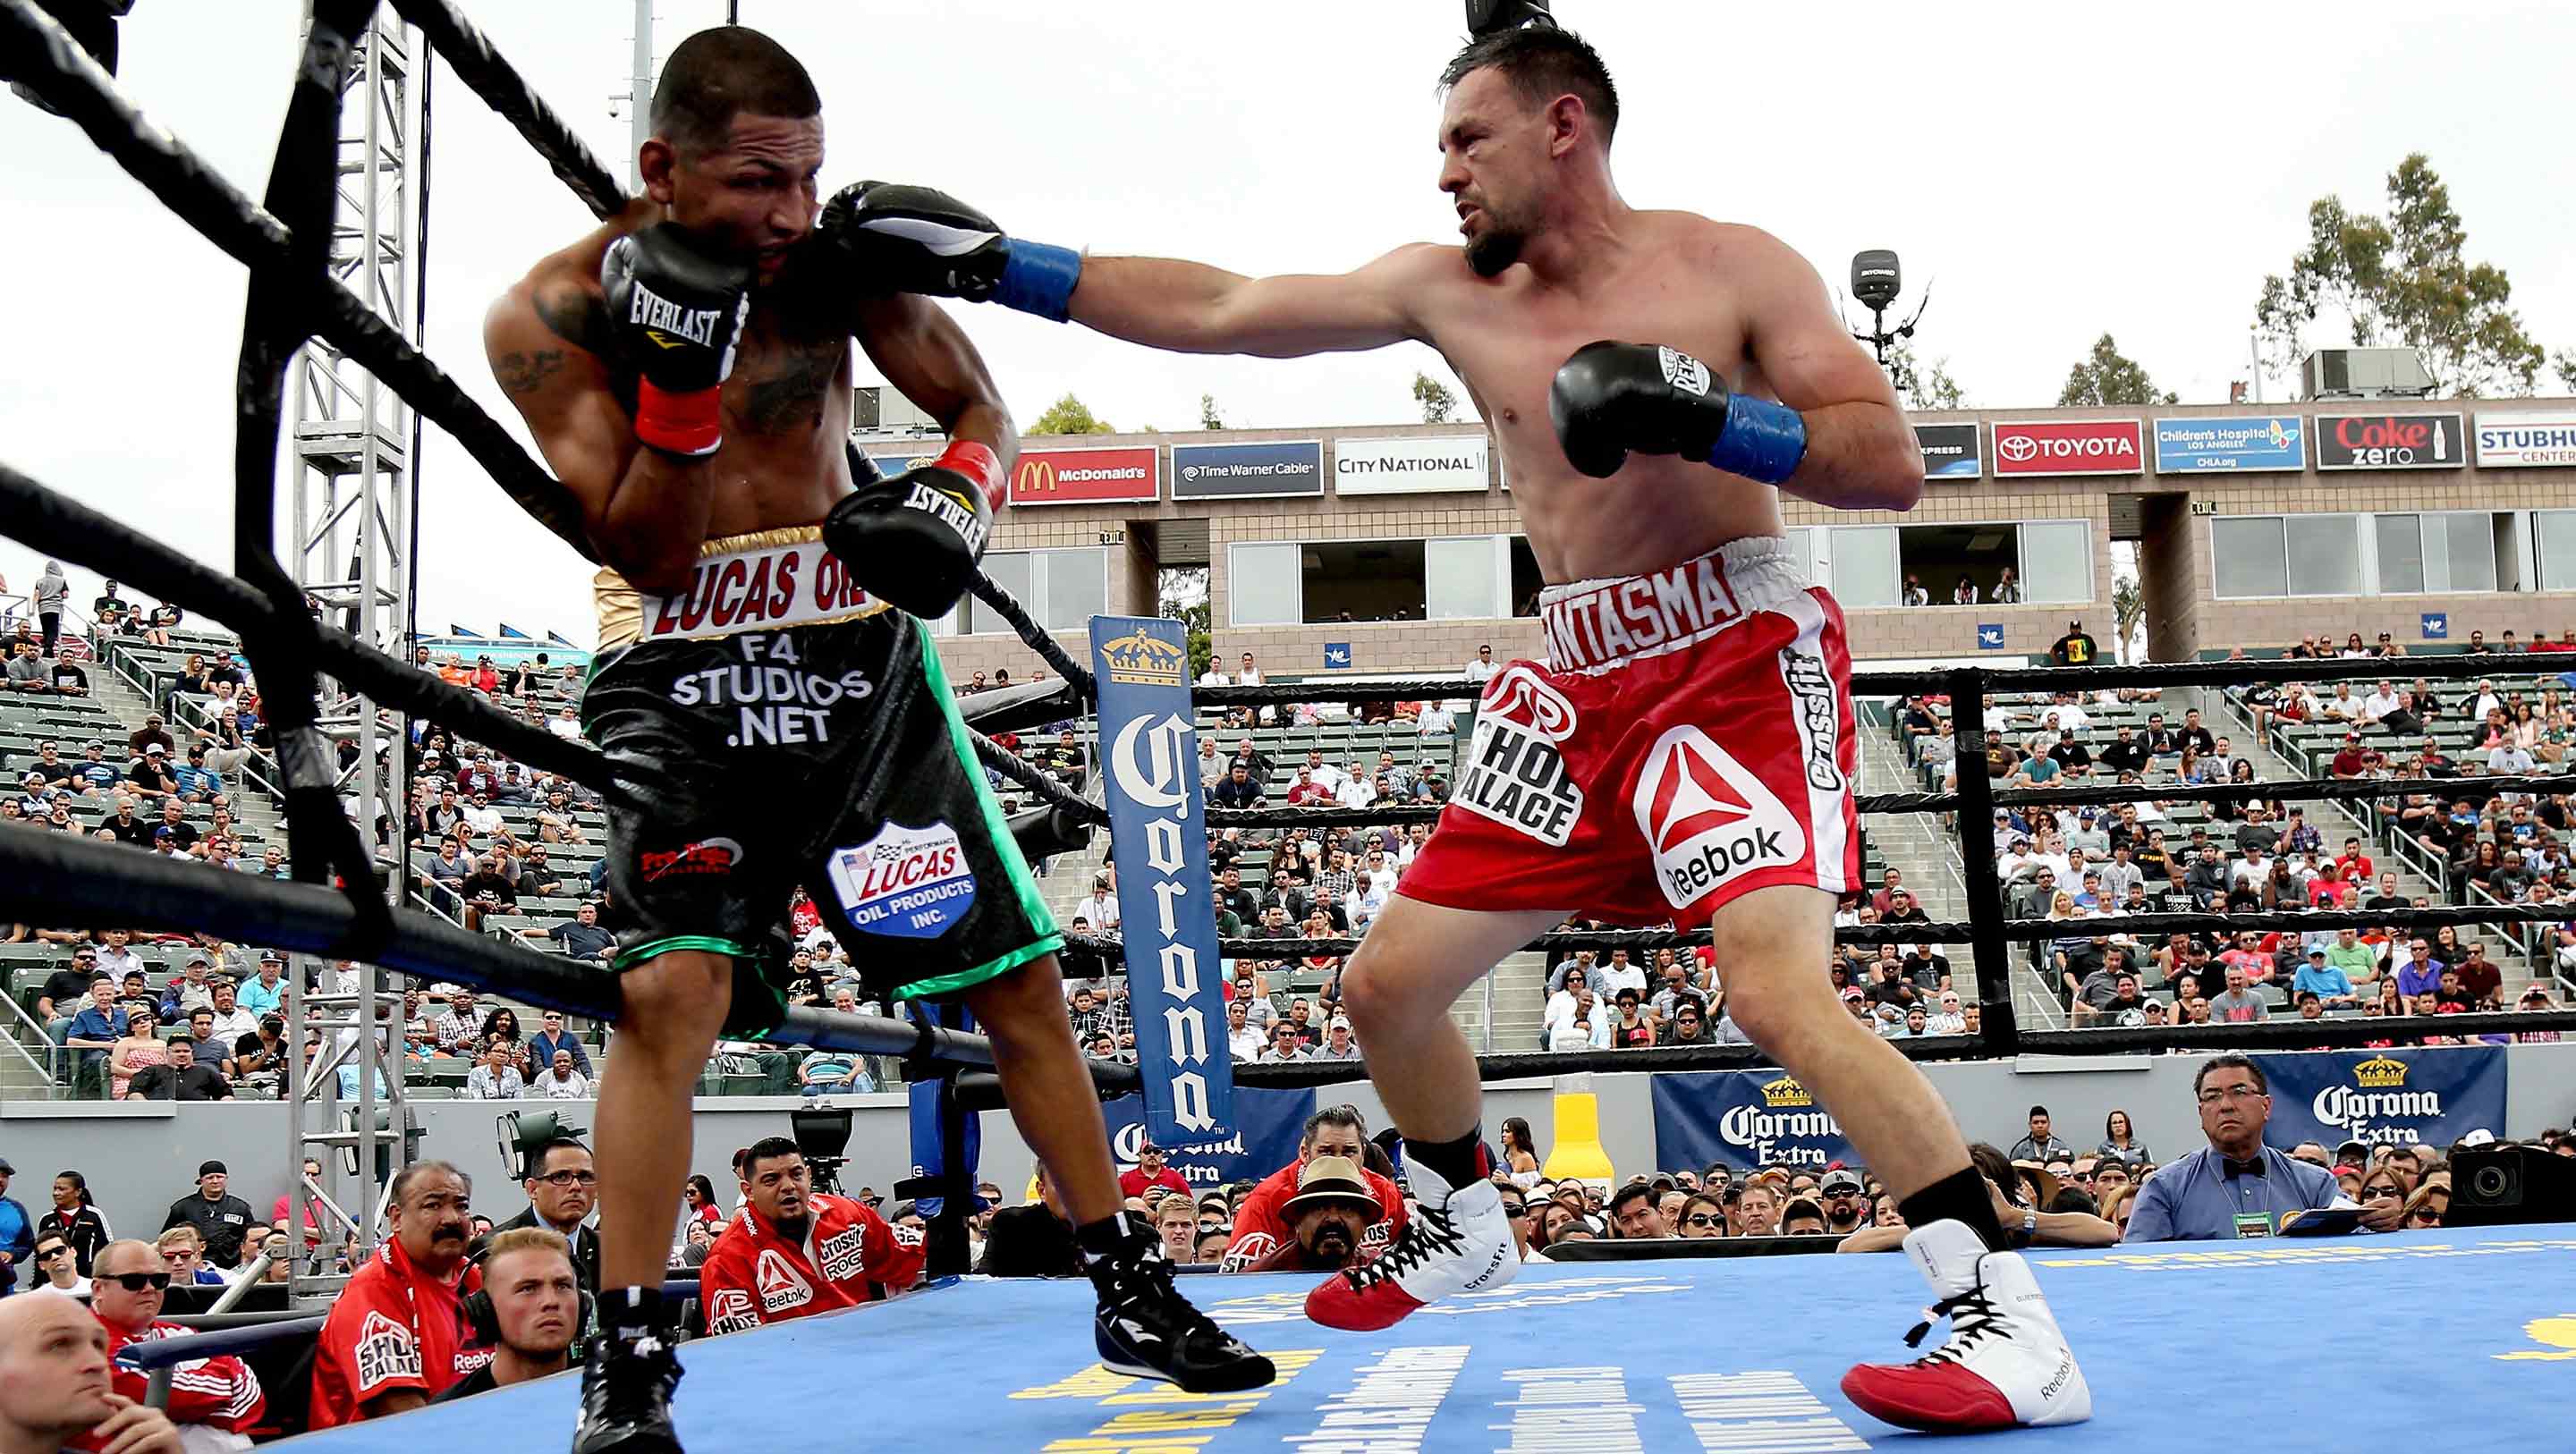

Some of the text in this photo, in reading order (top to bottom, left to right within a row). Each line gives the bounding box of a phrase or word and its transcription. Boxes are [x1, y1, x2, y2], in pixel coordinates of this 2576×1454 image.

[630, 280, 722, 348] EVERLAST
[2038, 437, 2134, 457] TOYOTA
[2160, 428, 2270, 444] Children's Hospital
[2188, 440, 2244, 450] LOS ANGELES
[2335, 418, 2428, 448] Coke
[2481, 430, 2576, 448] STUBH
[1919, 446, 1963, 454] XPRESS
[2197, 458, 2237, 467] CHLA.org
[2352, 447, 2413, 465] zero
[1058, 466, 1147, 483] McDonald's
[1199, 462, 1310, 478] Time Warner Cable
[1338, 457, 1475, 473] CITY NATIONAL
[902, 481, 987, 558] EVERLAST
[2196, 502, 2213, 515] EXIT
[651, 551, 800, 637] LUCAS
[1544, 553, 1739, 676] ANTASMA
[740, 634, 800, 665] F4
[670, 664, 874, 706] STUDIOS
[727, 706, 831, 748] .NET
[1472, 719, 1577, 804] HO
[1460, 766, 1575, 840] ALACE
[858, 846, 957, 901] LUCAS
[1665, 826, 1787, 901] Reebok
[854, 879, 974, 926] OIL PRODUCTS
[911, 909, 947, 930] INC.
[1111, 712, 1217, 1134] Corona
[2313, 1084, 2442, 1129] Corona
[2350, 1119, 2420, 1145] Extra
[1757, 1139, 1827, 1166] Extra
[761, 1288, 808, 1310] Reebok
[361, 1356, 420, 1385] PALAC
[454, 1351, 496, 1371] Reeb
[2041, 1357, 2073, 1401] Reebok
